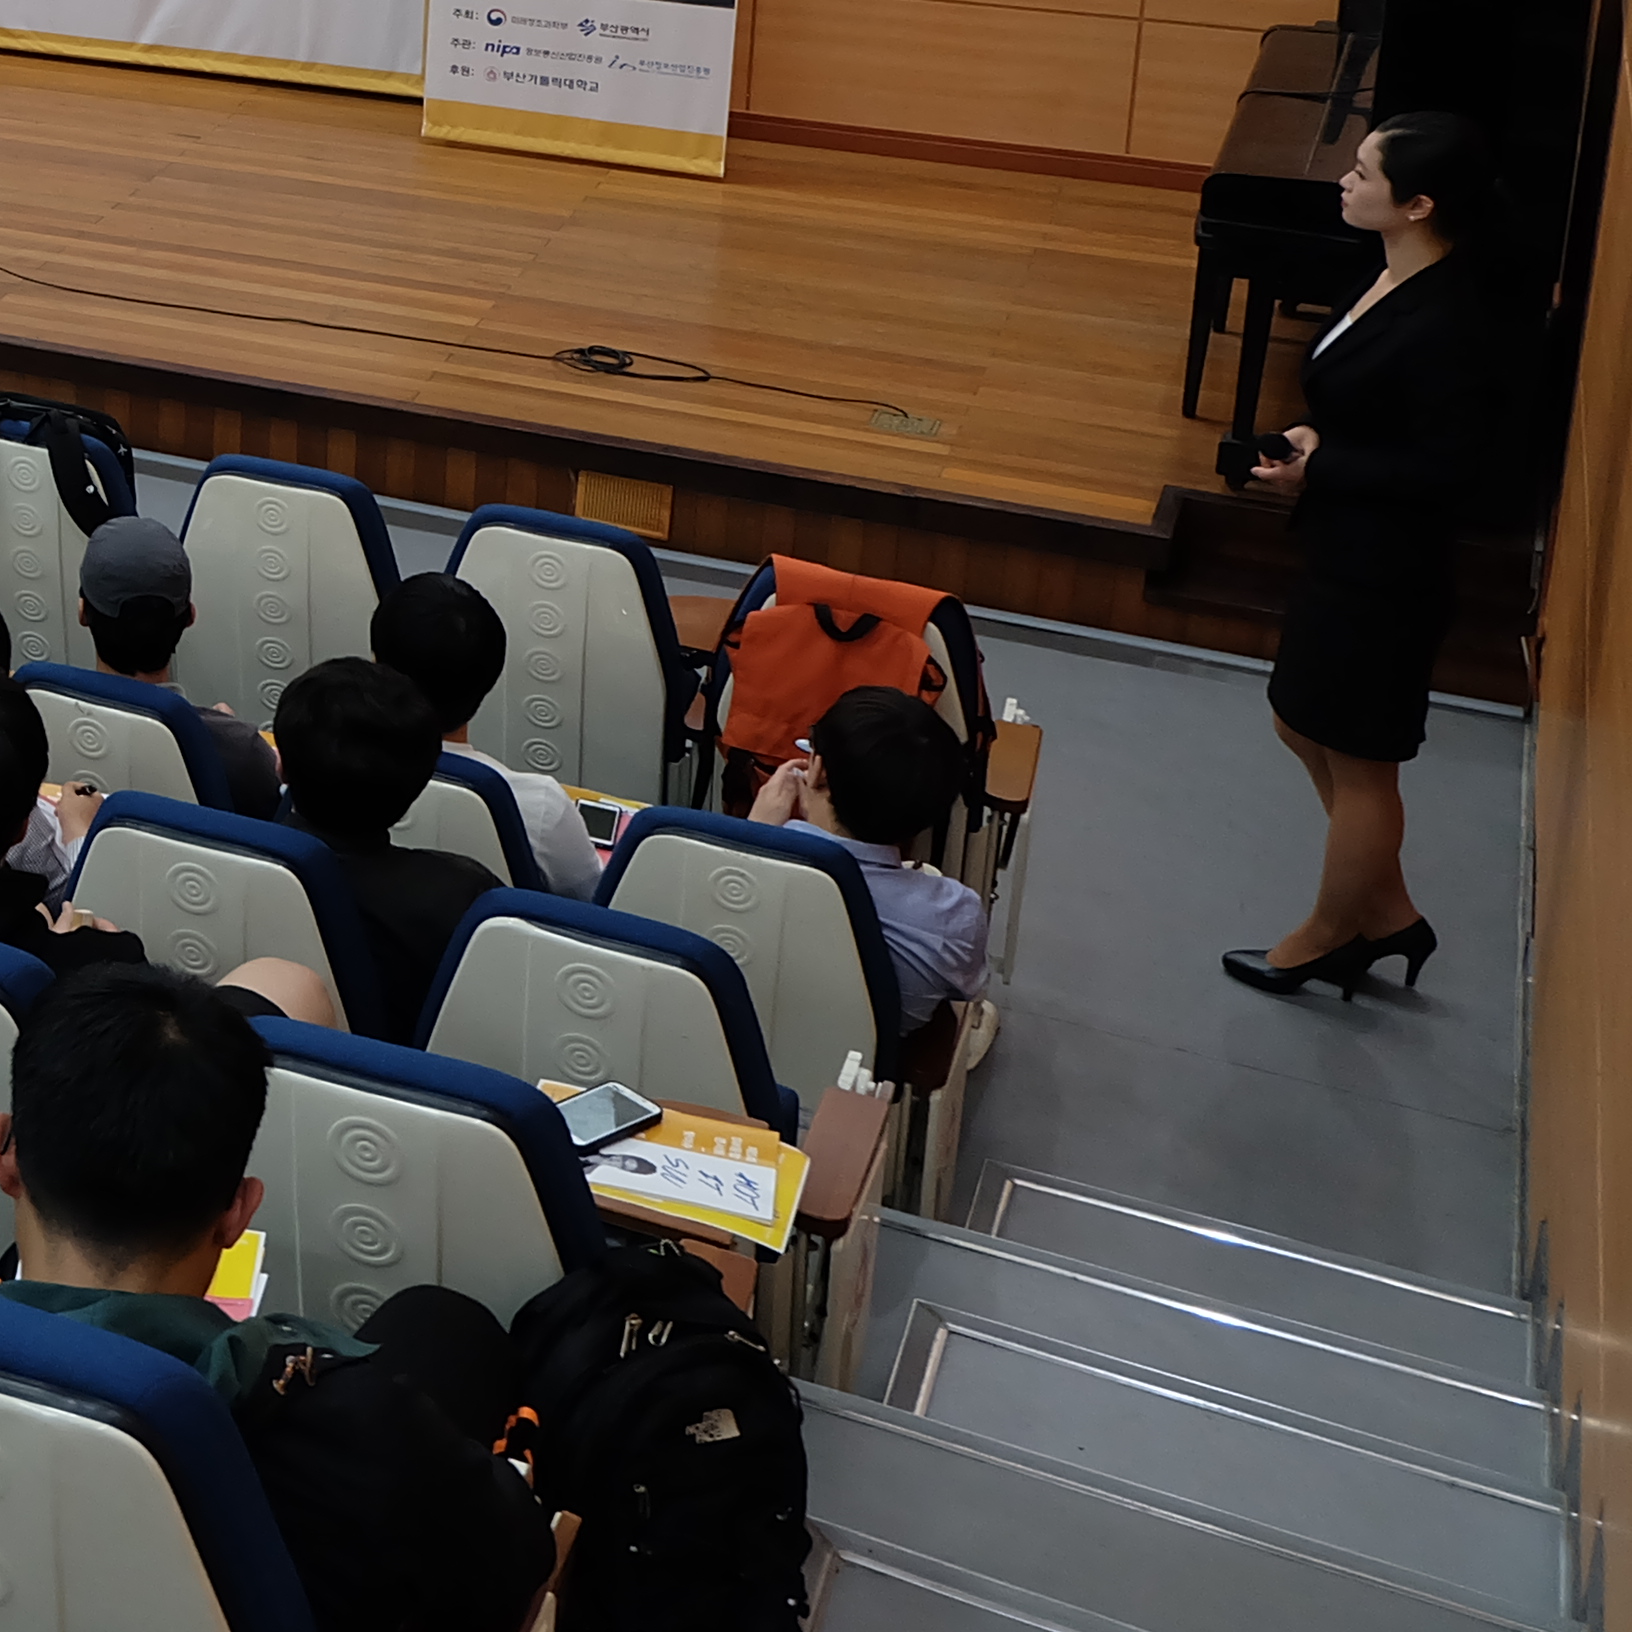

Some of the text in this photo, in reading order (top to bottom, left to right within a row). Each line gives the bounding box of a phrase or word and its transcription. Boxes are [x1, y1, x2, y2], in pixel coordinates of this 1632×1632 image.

[599, 22, 650, 36] 부산광역시
[484, 39, 521, 57] nipa
[732, 1171, 761, 1211] HOT
